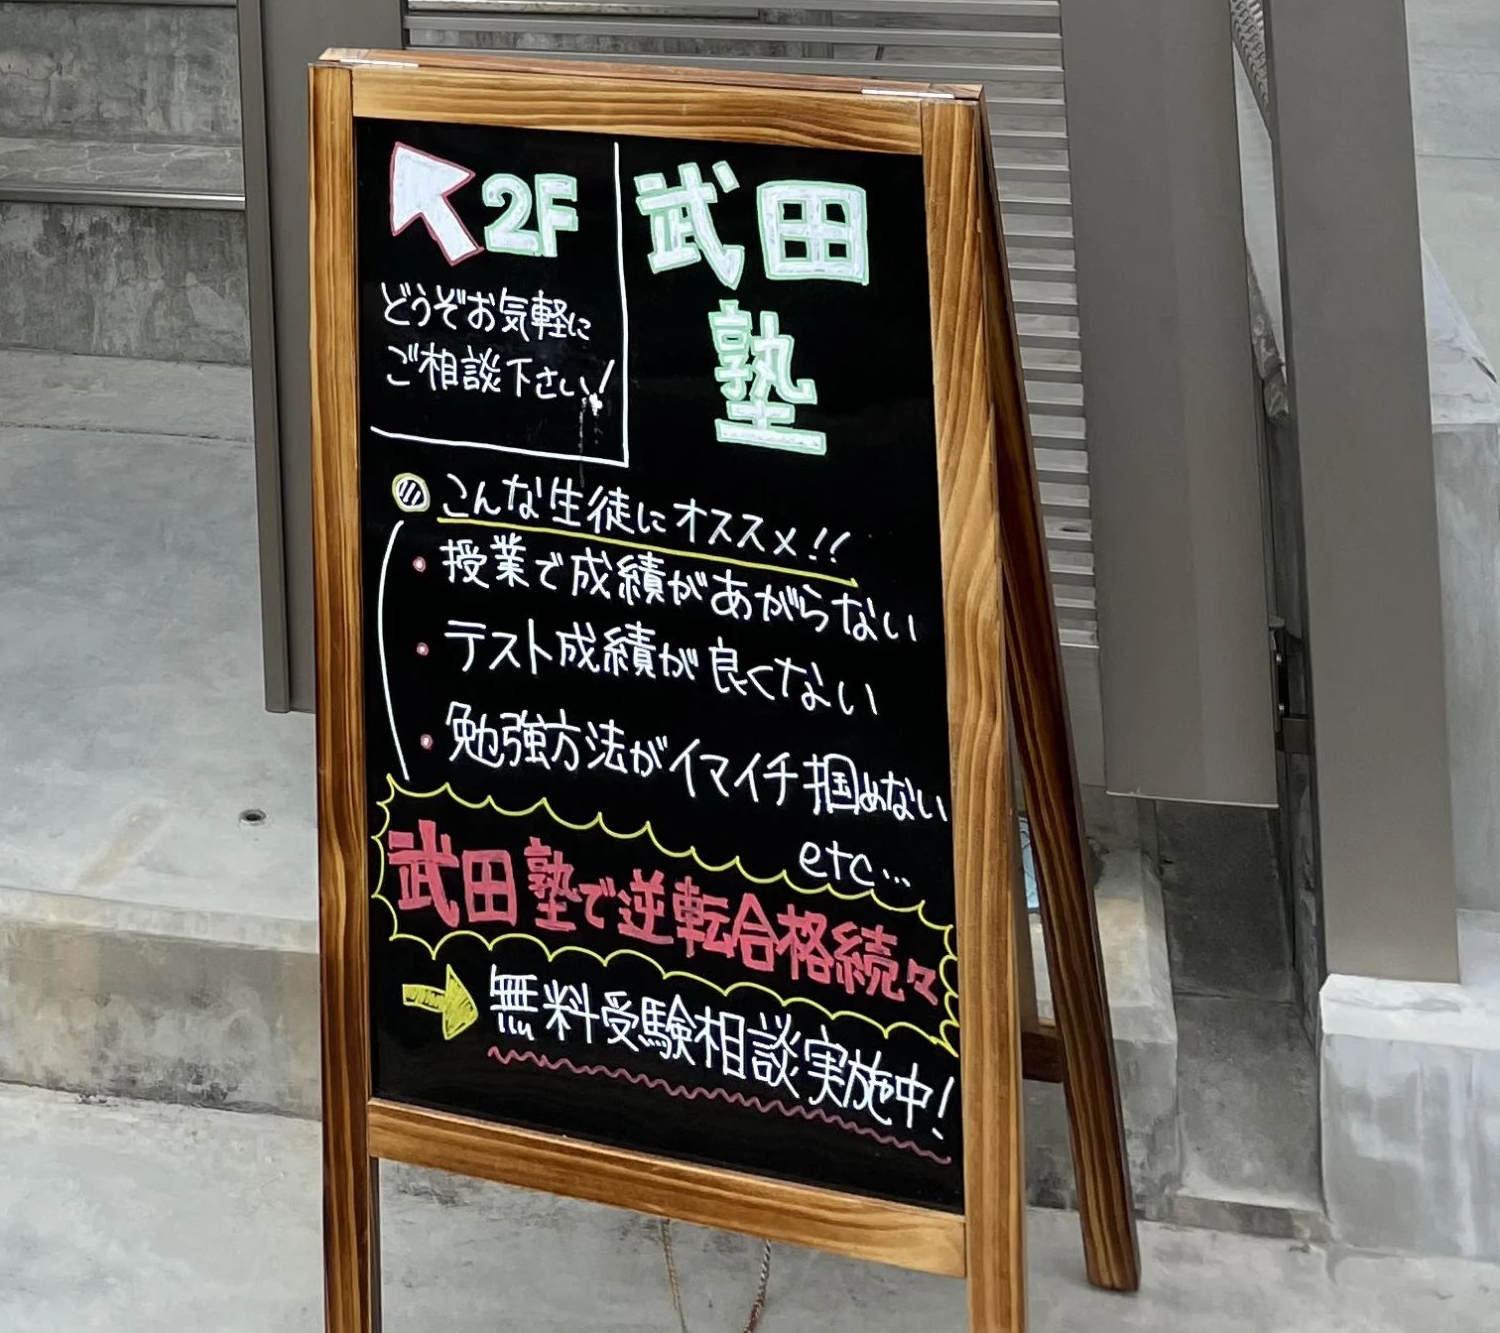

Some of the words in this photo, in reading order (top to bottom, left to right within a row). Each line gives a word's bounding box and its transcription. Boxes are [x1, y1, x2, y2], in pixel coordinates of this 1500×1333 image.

[482, 172, 579, 258] 2F
[634, 160, 870, 290] 武田
[381, 281, 592, 342] どうぞお気軽に
[707, 298, 827, 455] 塾
[440, 534, 918, 643] 授業で成績があがらない
[444, 618, 878, 717] テスト成績が良くない
[389, 820, 939, 1006] 武田塾で逆転合格続々
[488, 964, 956, 1140] 無料受験相談実施中!
